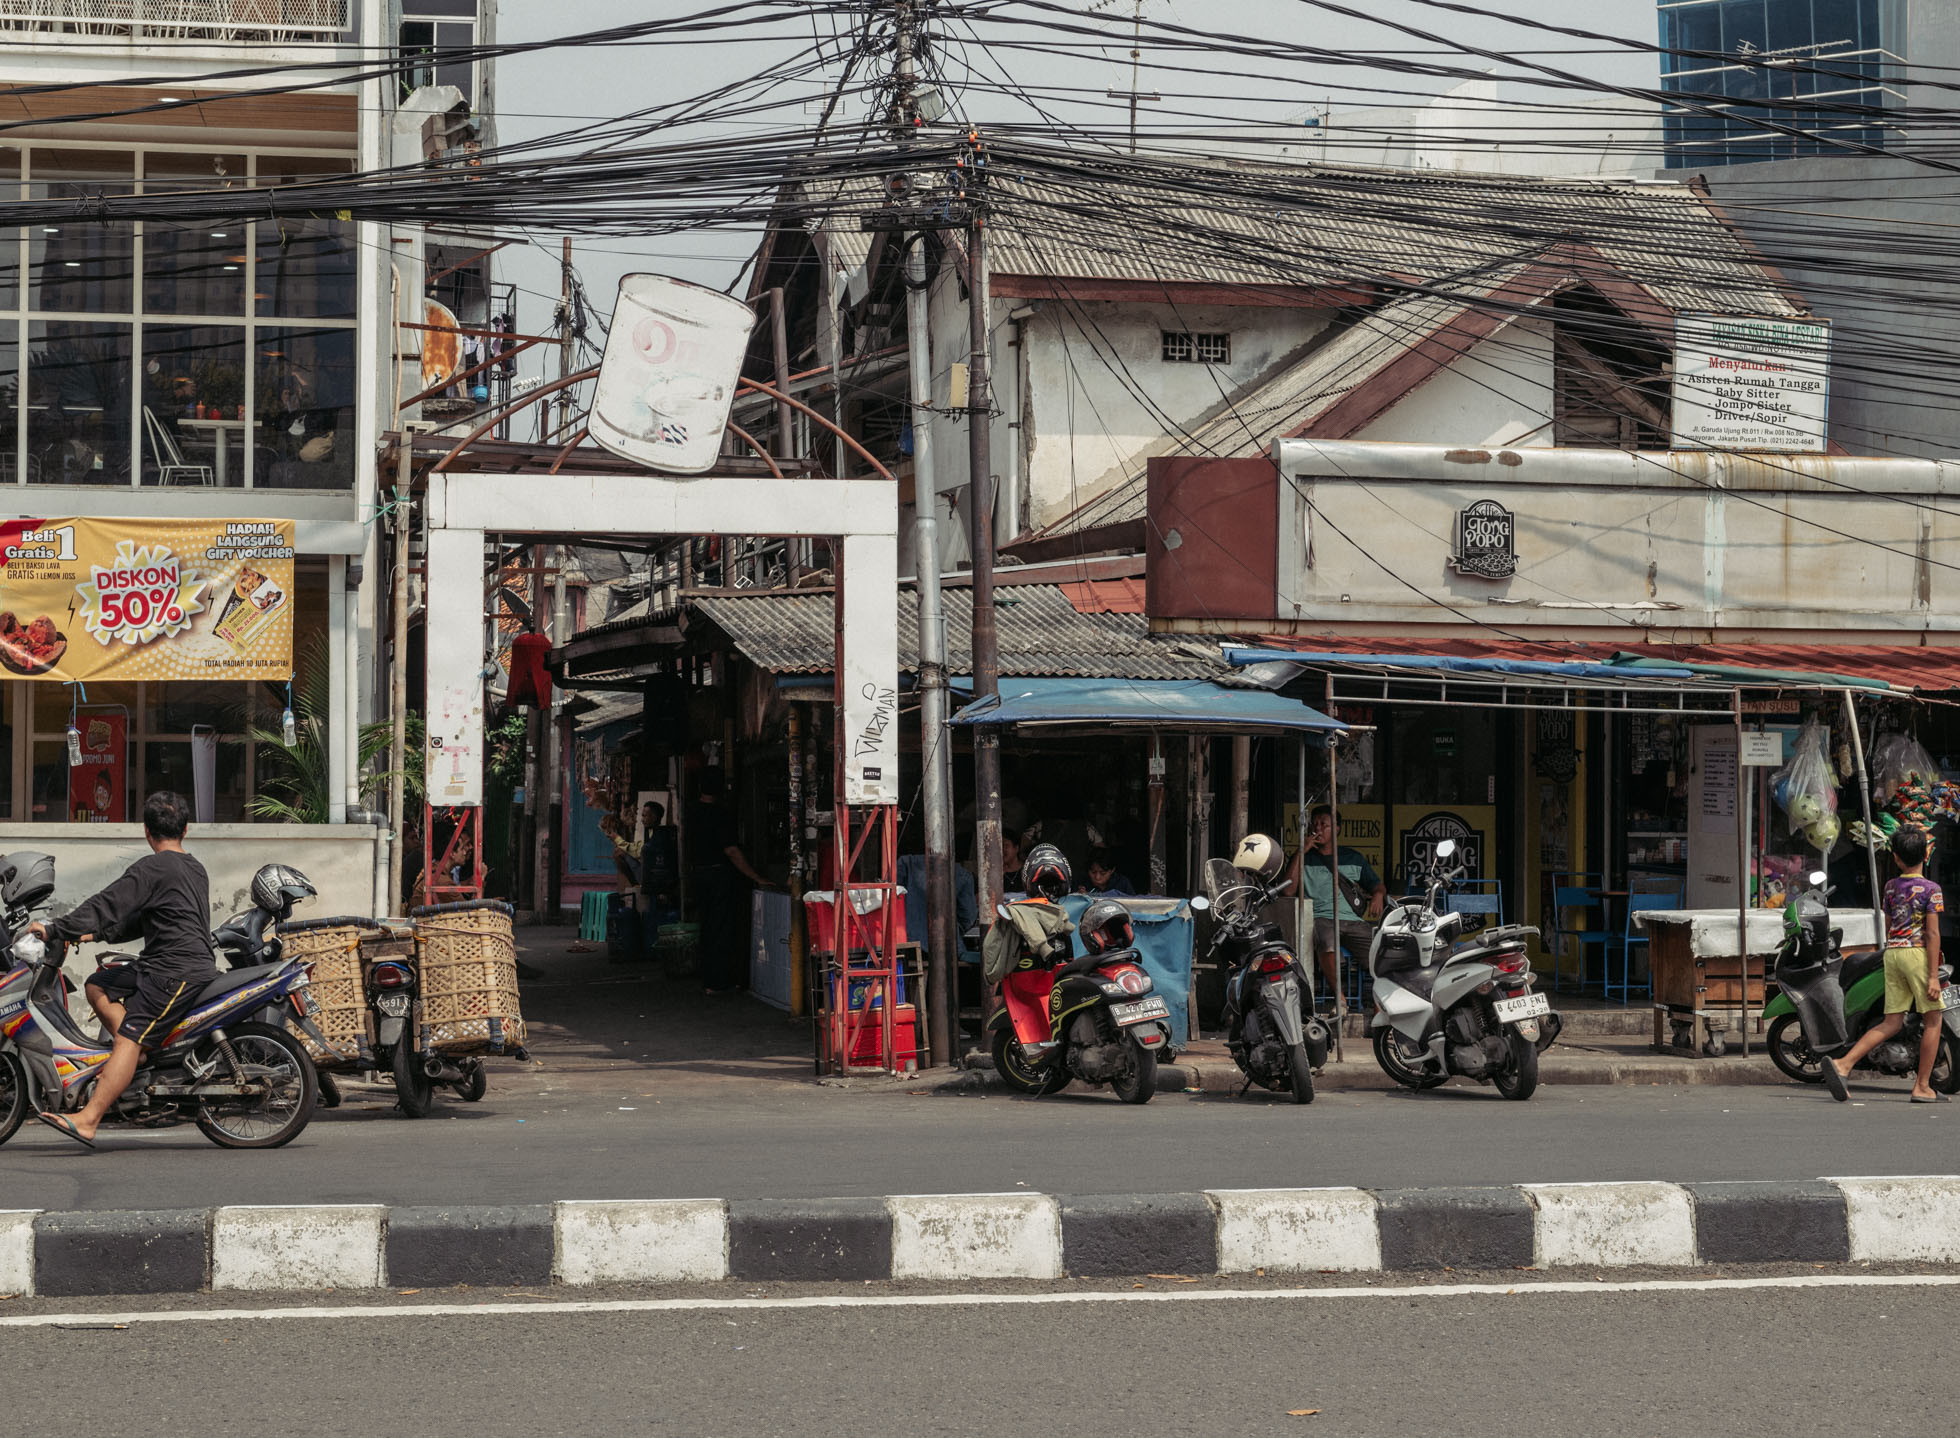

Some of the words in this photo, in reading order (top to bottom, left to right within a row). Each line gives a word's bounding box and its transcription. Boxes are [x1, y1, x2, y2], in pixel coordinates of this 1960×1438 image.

[1709, 357, 1787, 372] Menyalurkan
[1688, 374, 1731, 385] Asisten
[1734, 376, 1776, 387] Rumah
[1779, 378, 1821, 391] Tangga
[1716, 387, 1743, 399] Baby
[1746, 389, 1780, 399] Sitter
[1715, 399, 1754, 411] Jompo
[1757, 401, 1792, 411] Sister
[1714, 411, 1788, 425] Driver/Sopir
[1724, 427, 1741, 436] Ujung
[226, 522, 275, 535] HADIAH
[21, 529, 55, 542] Beli
[55, 525, 78, 561] 1
[216, 534, 284, 547] LANGSUNG
[1465, 529, 1504, 547] POPO
[4, 545, 55, 559] Gratis
[206, 548, 235, 560] GIFT
[236, 547, 294, 560] VOUCHER
[7, 570, 35, 580] GRATIS
[97, 566, 176, 590] DISKON
[100, 587, 181, 628] 50%
[1769, 701, 1797, 712] SUSU
[102, 753, 115, 764] JUNI
[0, 1002, 22, 1016] AMAHA
[1496, 1003, 1504, 1013] B
